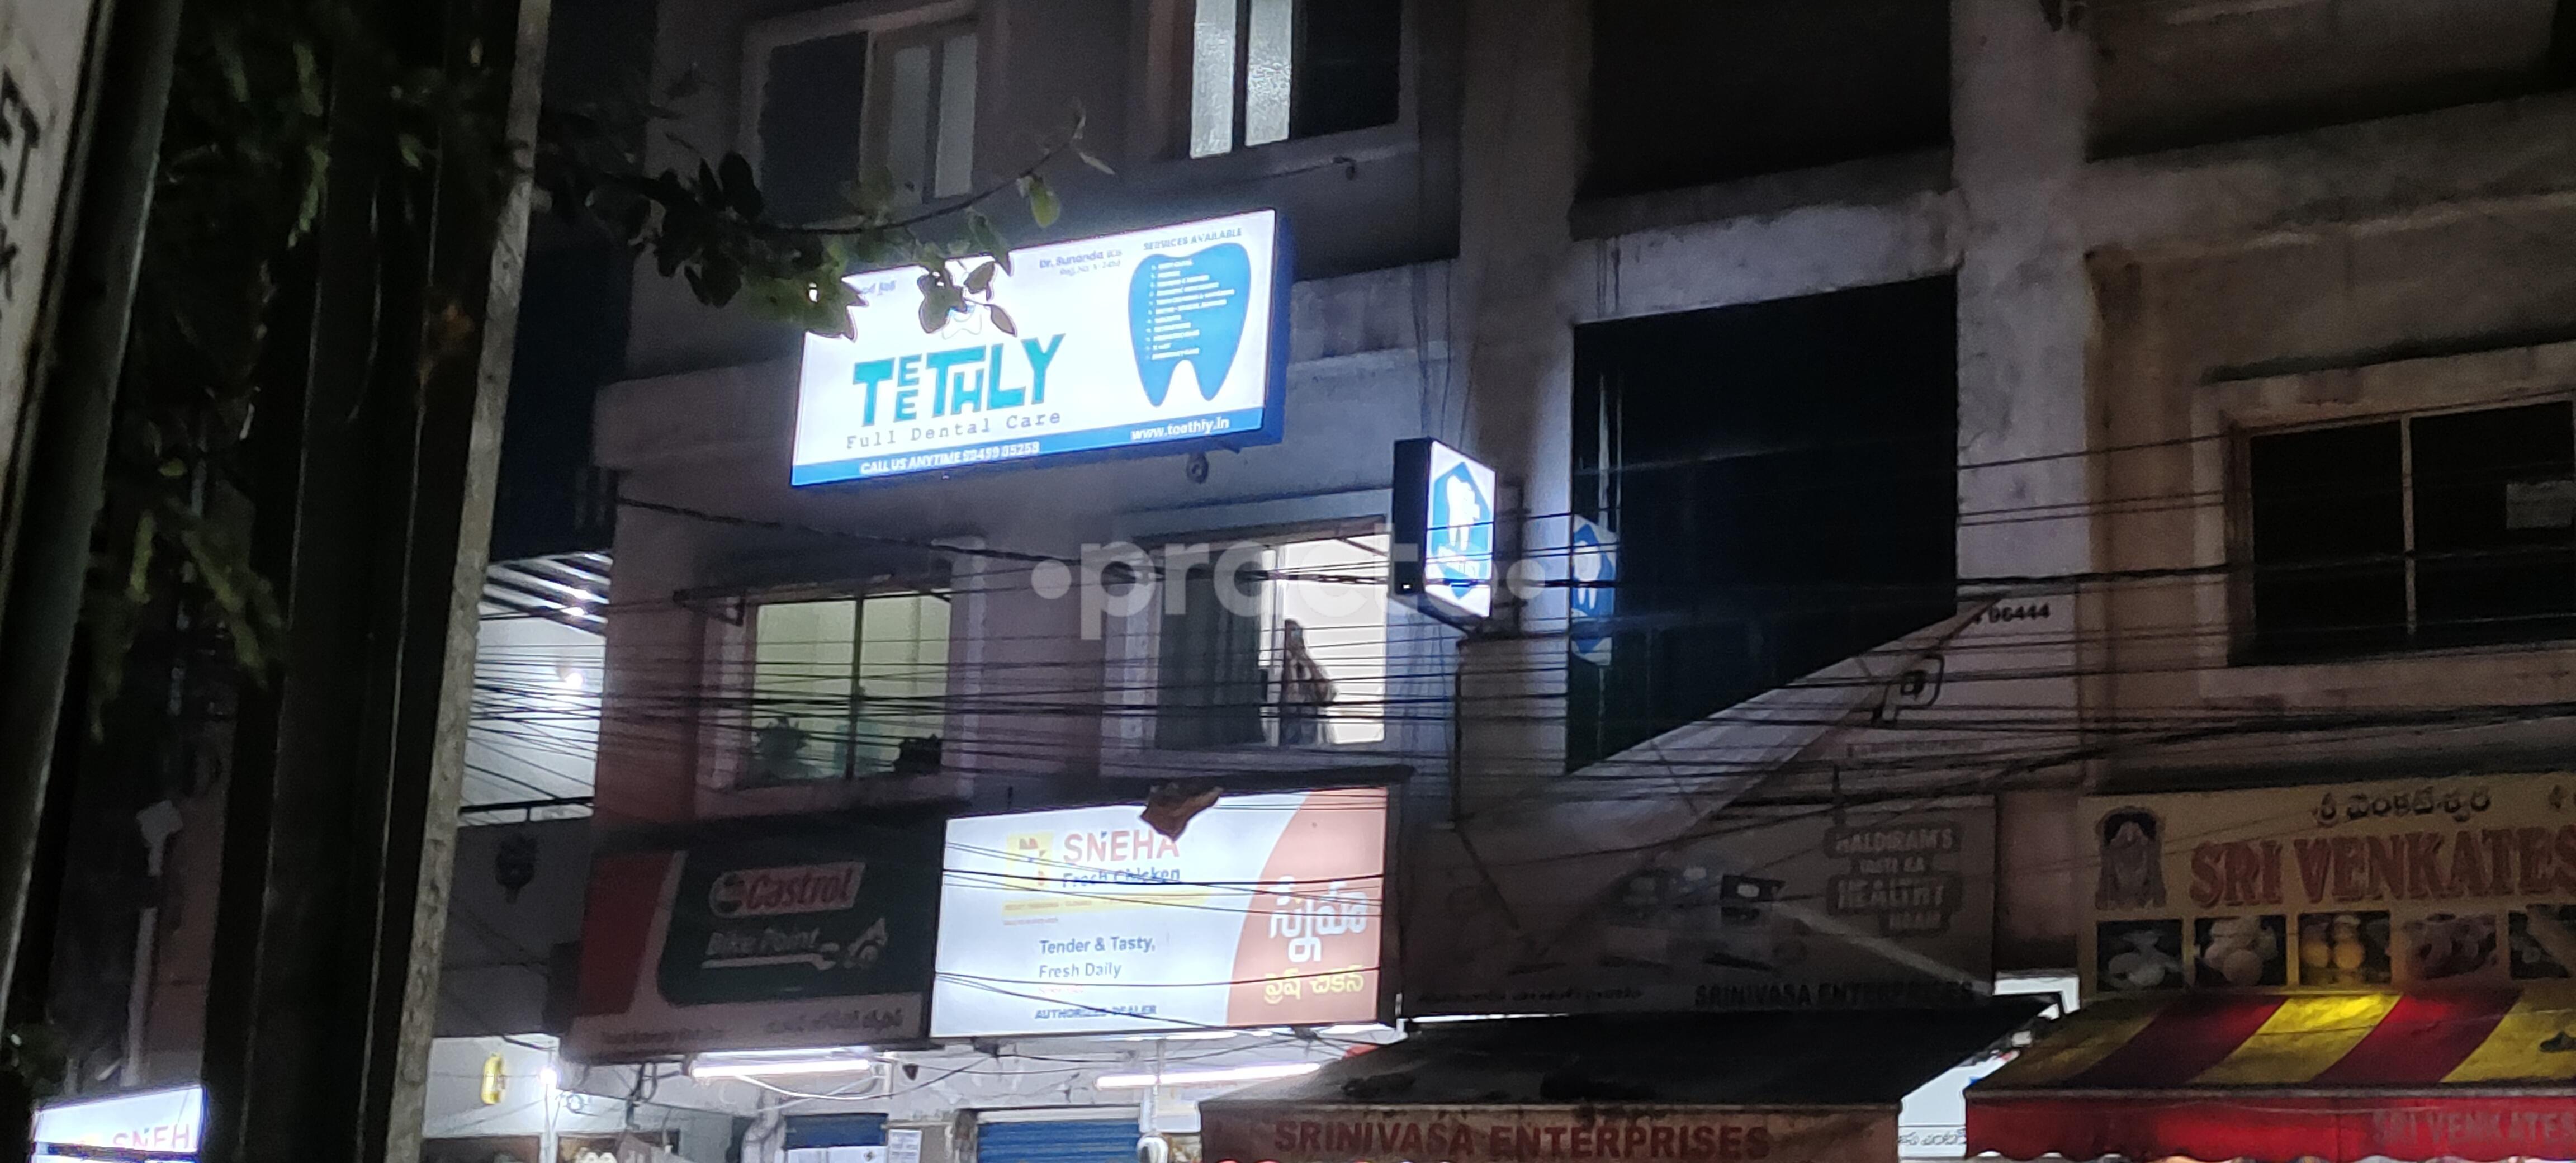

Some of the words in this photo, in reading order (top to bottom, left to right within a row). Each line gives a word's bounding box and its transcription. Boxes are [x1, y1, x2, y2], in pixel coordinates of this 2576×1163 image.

[1143, 235, 1188, 250] SERVICES
[1190, 228, 1242, 244] AVAILABLE
[847, 429, 896, 450] Full
[911, 418, 991, 441] Dental
[1006, 412, 1060, 429] Care
[860, 460, 889, 474] CALL
[891, 458, 907, 471] US
[908, 451, 962, 469] ANYTIME
[1063, 829, 1180, 863] SNEHA
[746, 868, 854, 910] Castrol
[2189, 840, 2283, 909] SRI
[1038, 938, 1091, 954] Tender
[1094, 936, 1105, 952] &
[1038, 963, 1079, 978] Fresh
[1085, 961, 1122, 979] Daily
[112, 1123, 197, 1150] SNEH
[1273, 1119, 1474, 1156] SRINIVASA
[1489, 1123, 1771, 1160] ENTERPRISES
